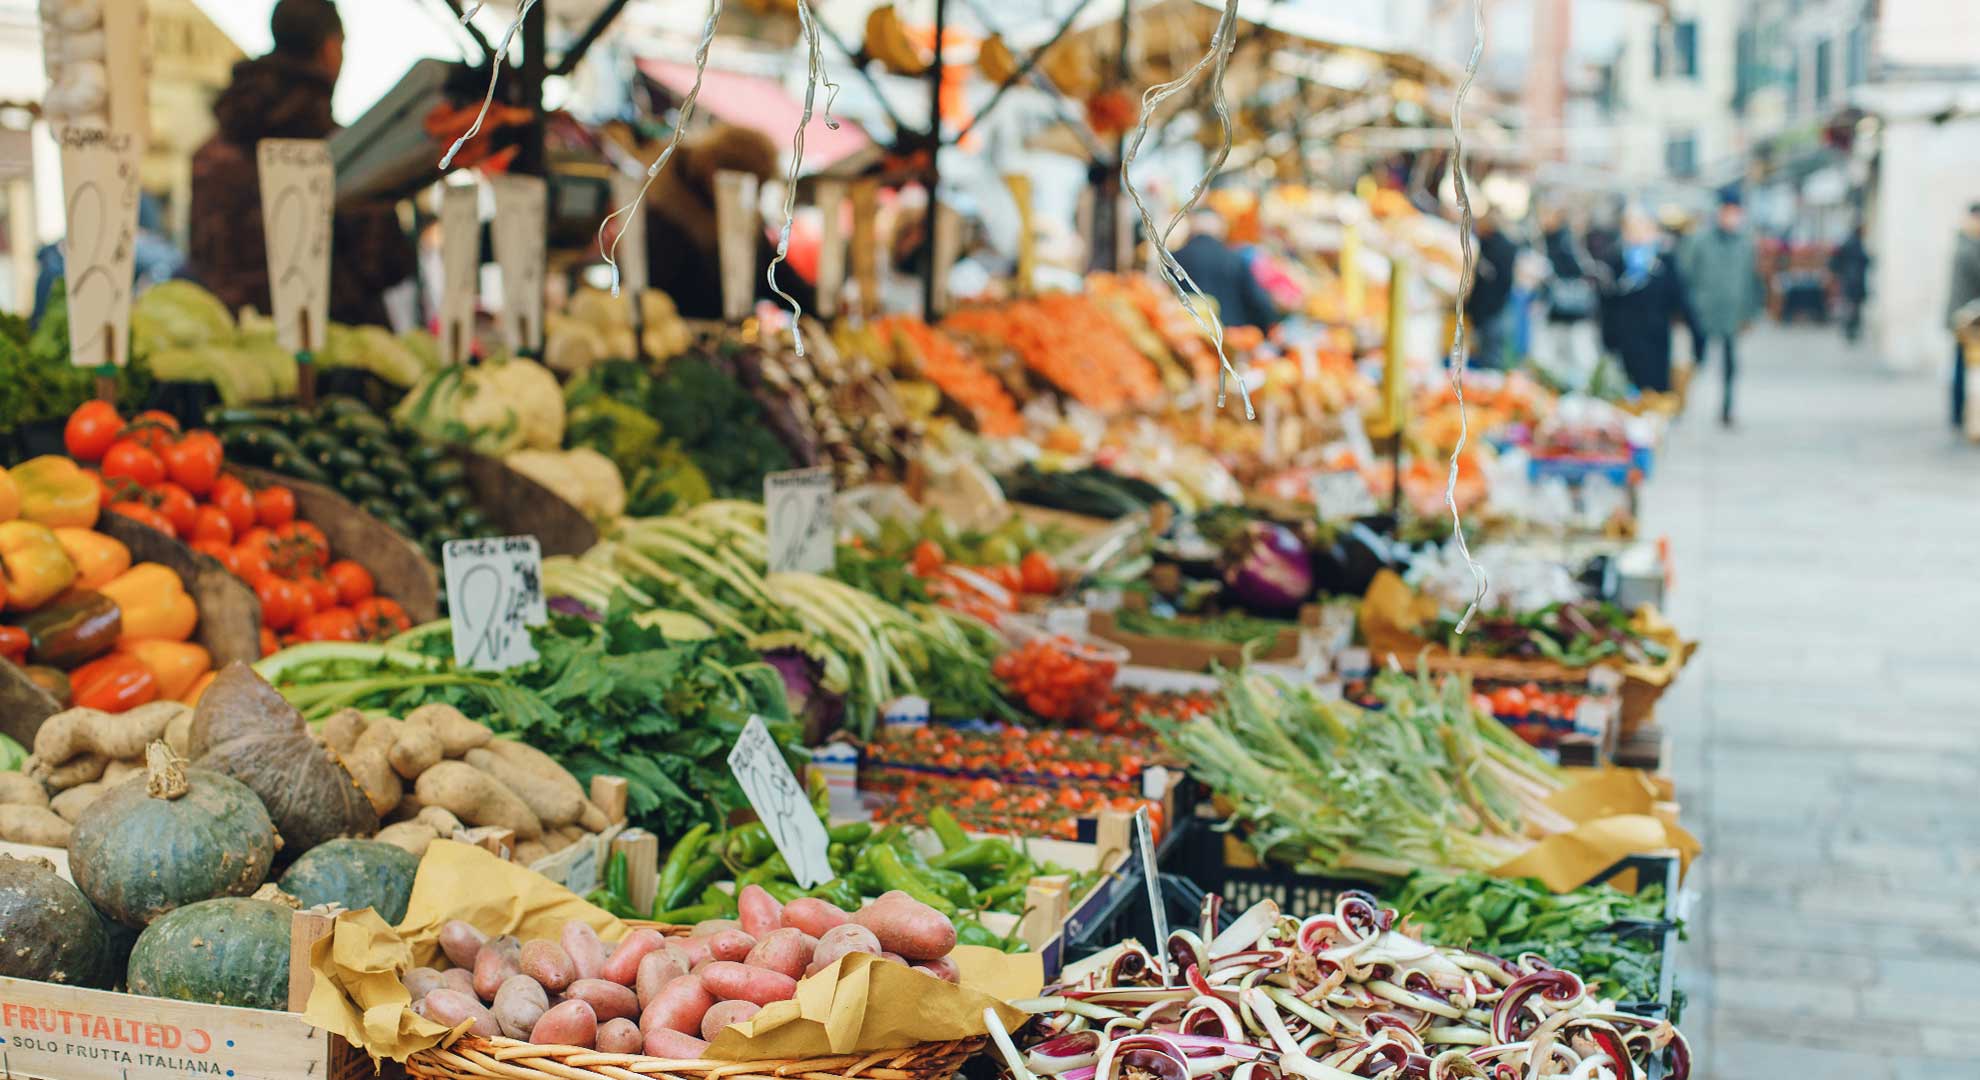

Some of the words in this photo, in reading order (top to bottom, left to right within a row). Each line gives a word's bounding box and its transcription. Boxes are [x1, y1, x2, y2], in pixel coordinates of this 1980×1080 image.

[13, 1036, 58, 1053] SOLO
[66, 1043, 132, 1064] FRUTTA
[139, 1053, 221, 1075] ITALIANA
